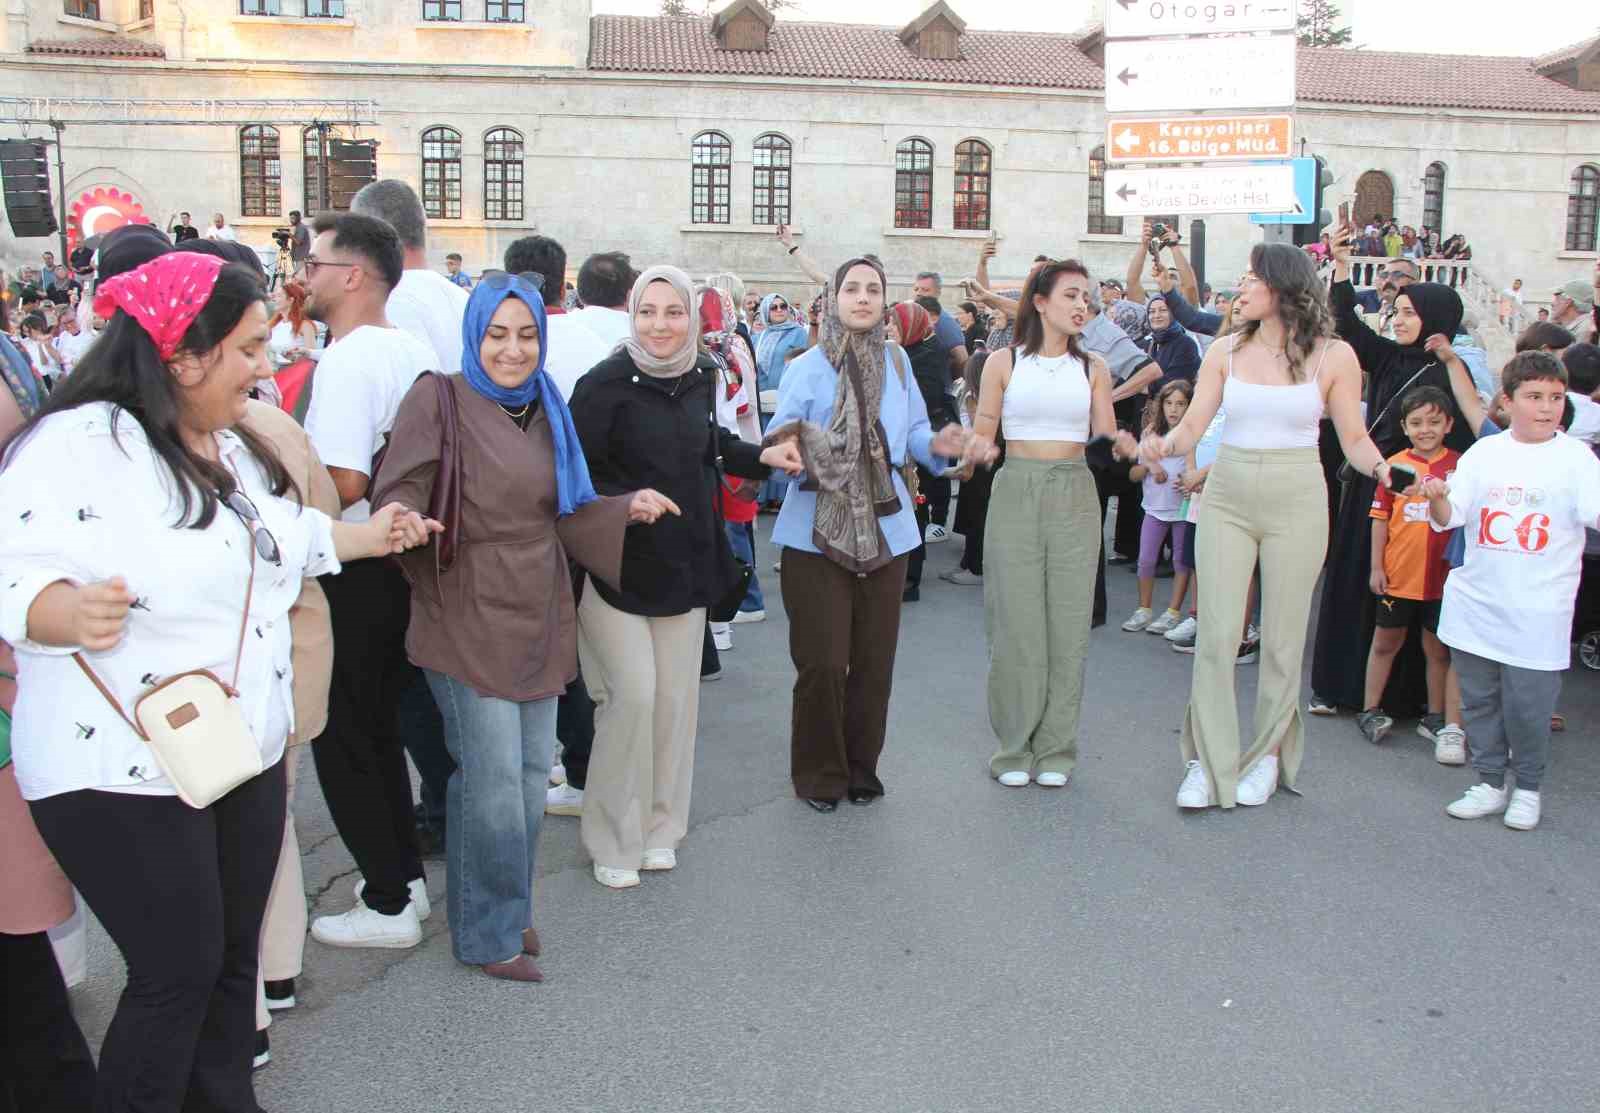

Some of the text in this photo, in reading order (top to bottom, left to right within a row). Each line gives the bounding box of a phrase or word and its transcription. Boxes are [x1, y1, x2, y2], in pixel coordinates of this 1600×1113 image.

[1149, 2, 1253, 22] Otogar
[1148, 140, 1174, 154] 16.
[1140, 193, 1185, 208] Sivas
